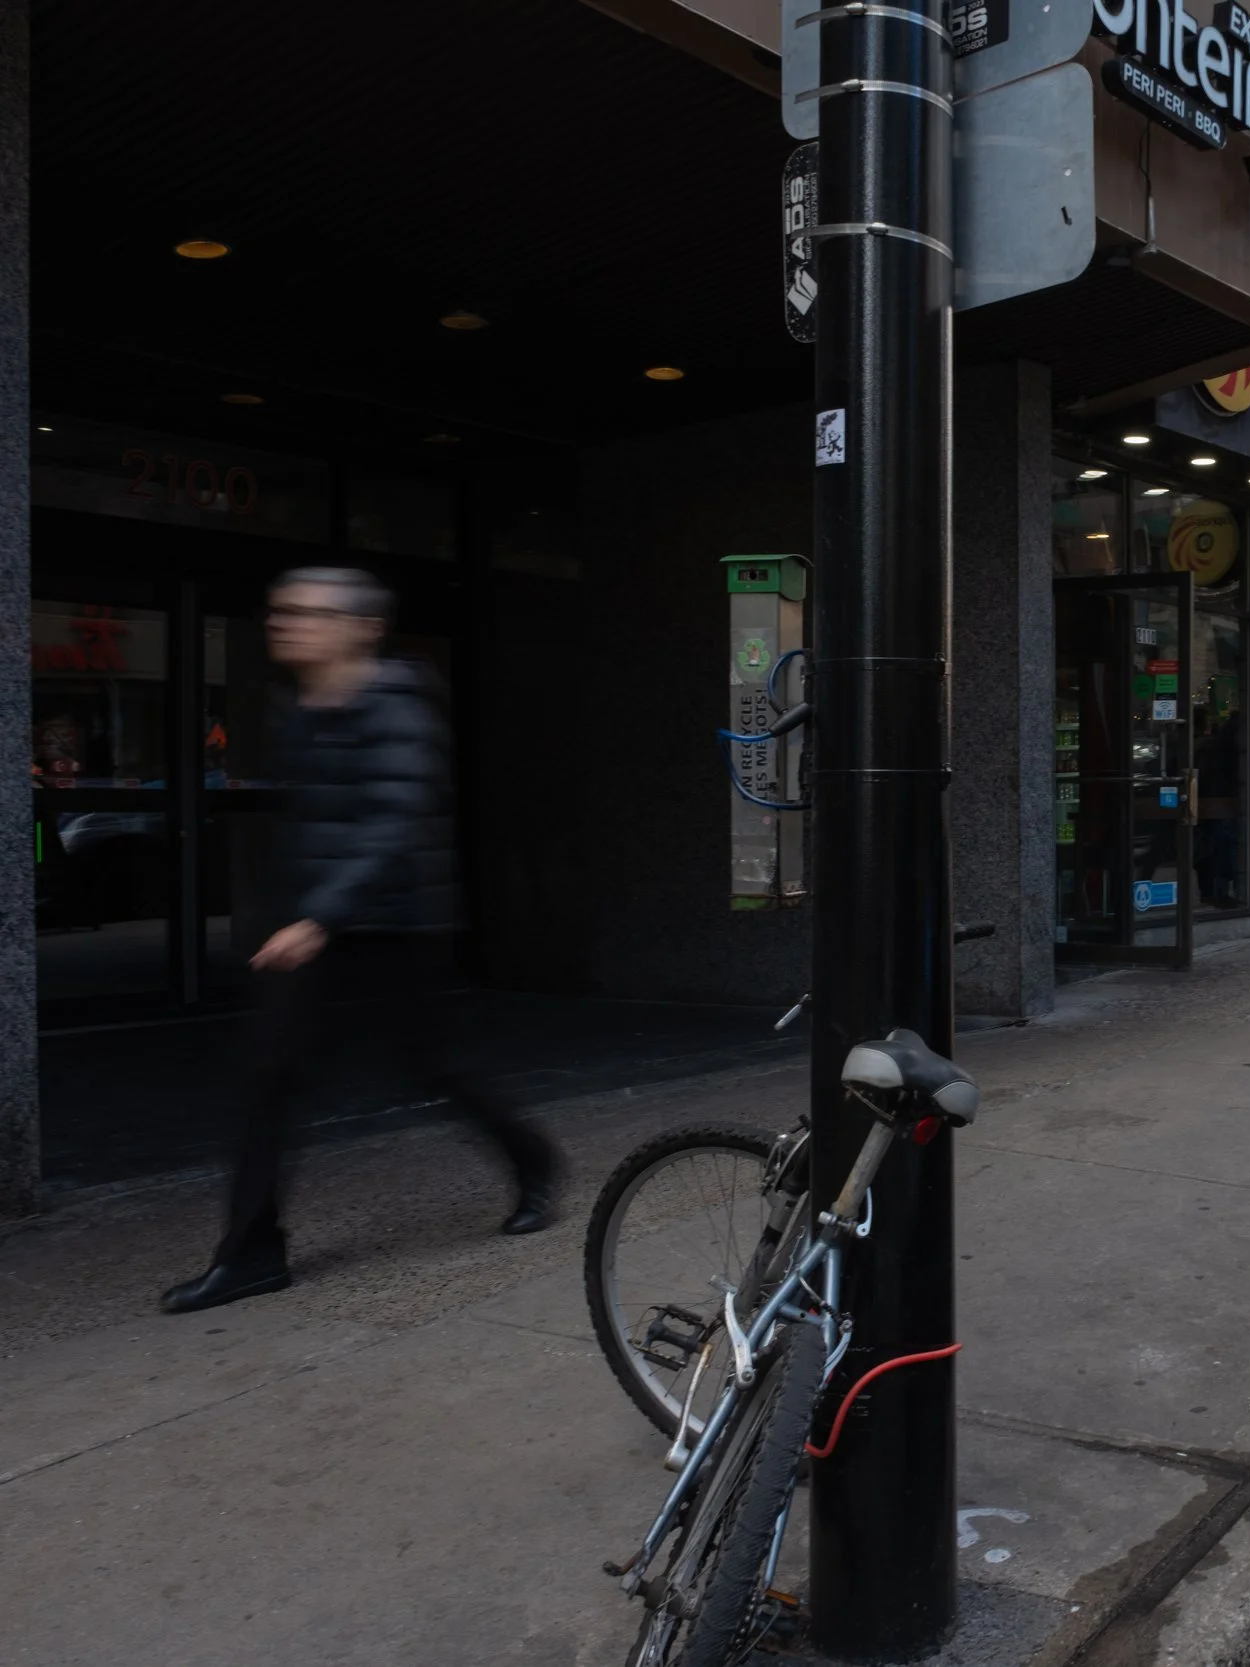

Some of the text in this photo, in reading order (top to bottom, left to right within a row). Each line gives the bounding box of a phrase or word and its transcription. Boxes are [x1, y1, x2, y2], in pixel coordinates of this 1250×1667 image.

[951, 7, 988, 37] DS
[1123, 63, 1221, 144] PERI PERI BBQ
[121, 448, 258, 515] 2100
